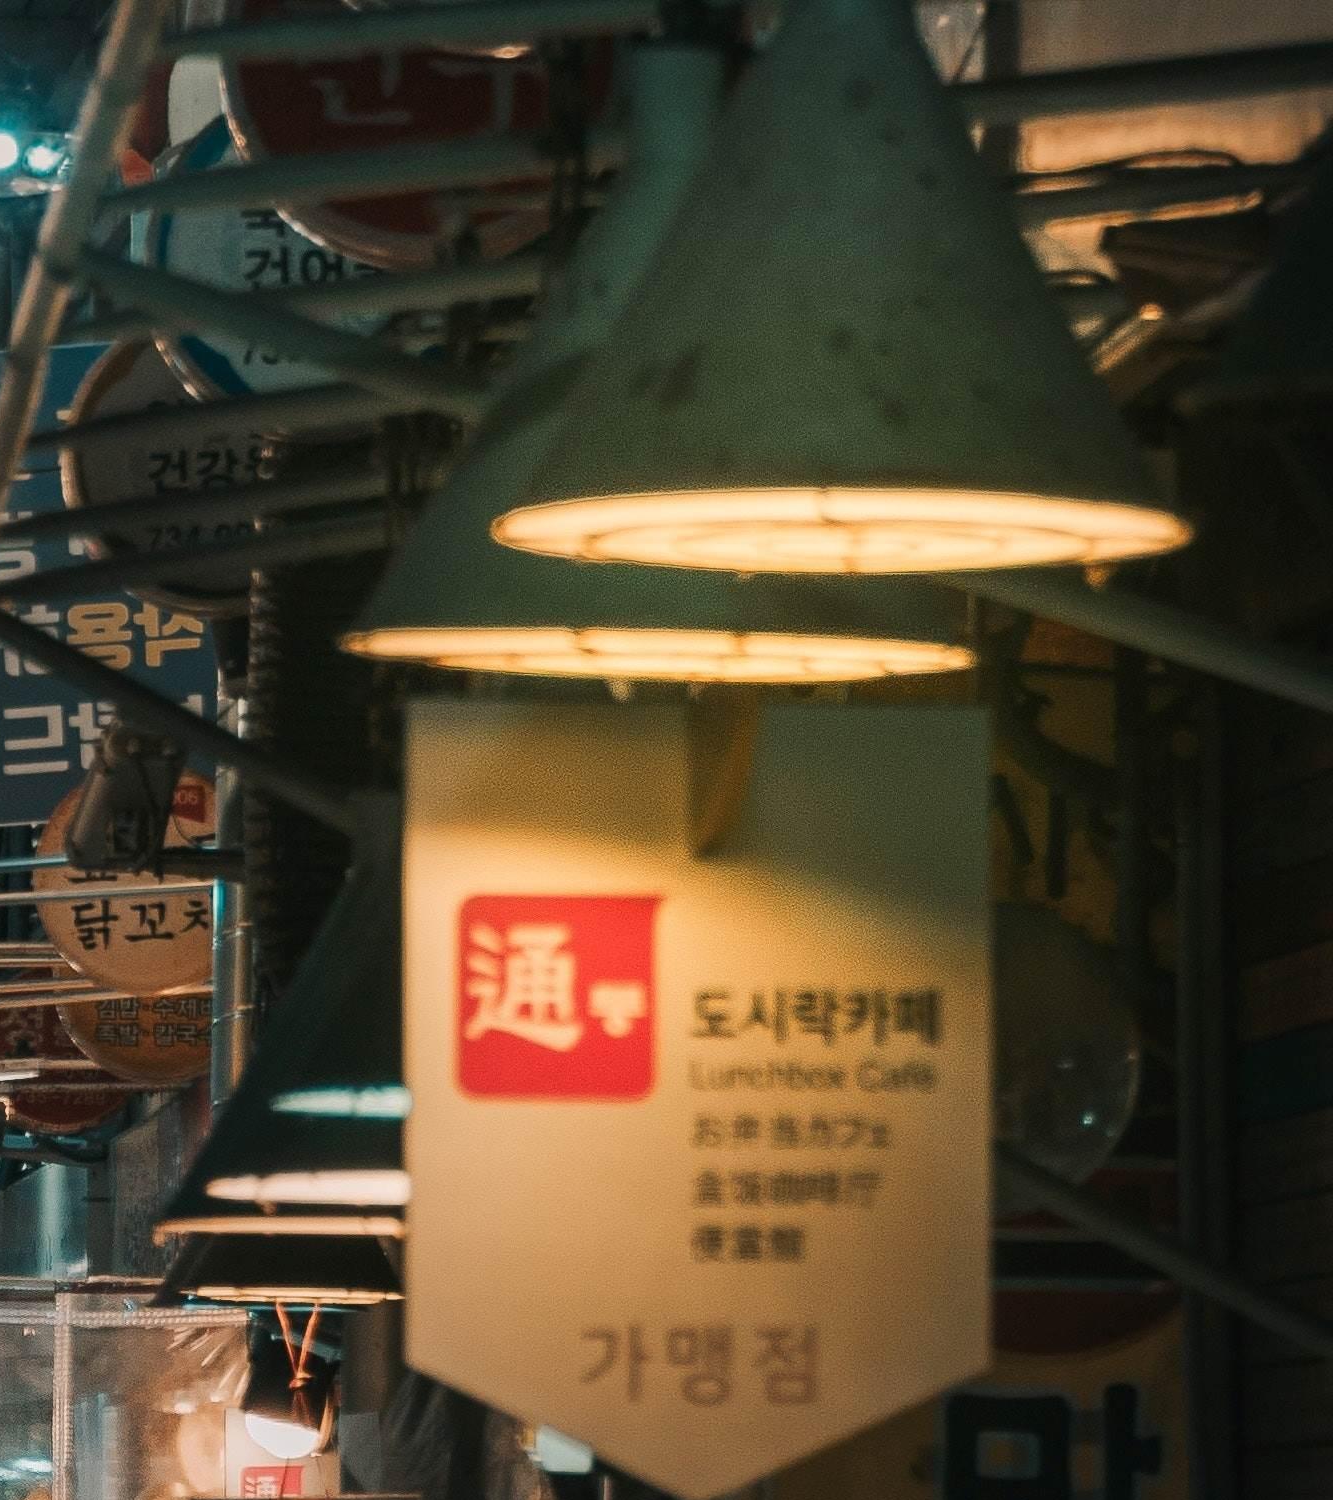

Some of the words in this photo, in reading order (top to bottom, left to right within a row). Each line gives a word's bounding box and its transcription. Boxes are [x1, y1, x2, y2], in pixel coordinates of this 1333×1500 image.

[690, 985, 945, 1045] 도시락카페
[688, 1058, 845, 1093] Lunchbox
[579, 1320, 821, 1402] 가맹점
